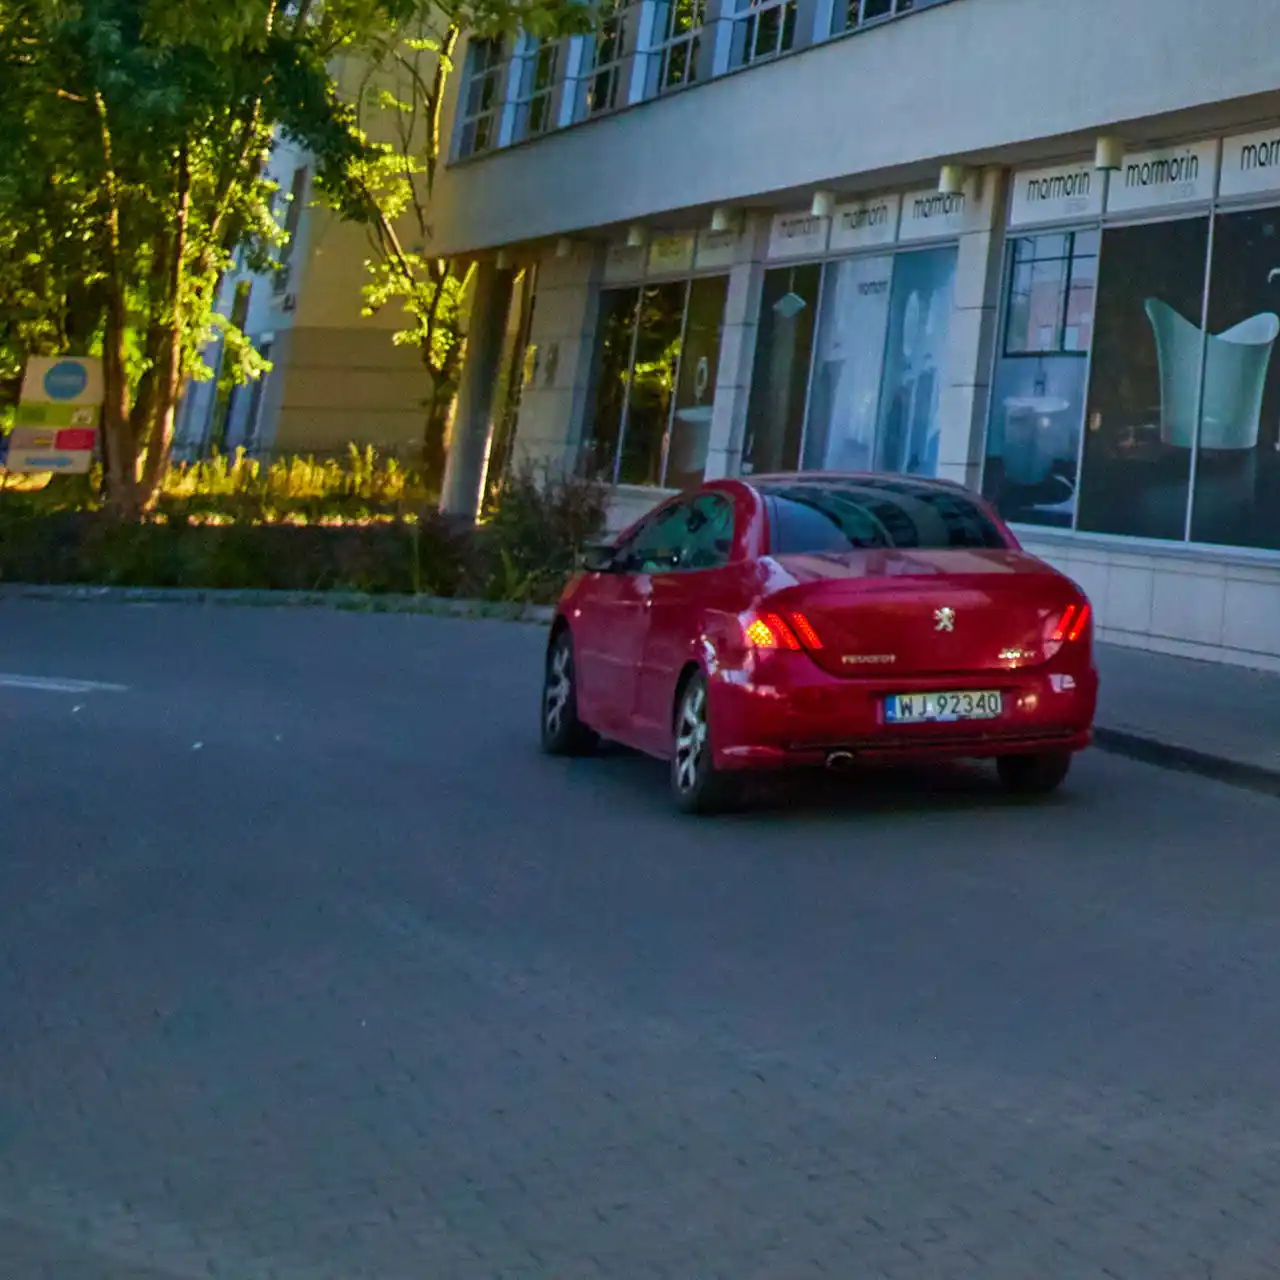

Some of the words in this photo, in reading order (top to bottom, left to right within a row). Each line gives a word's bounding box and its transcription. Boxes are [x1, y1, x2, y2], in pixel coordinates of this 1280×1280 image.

[1125, 149, 1199, 188] marmorin
[899, 697, 927, 718] WJ
[937, 693, 1000, 716] 92340
